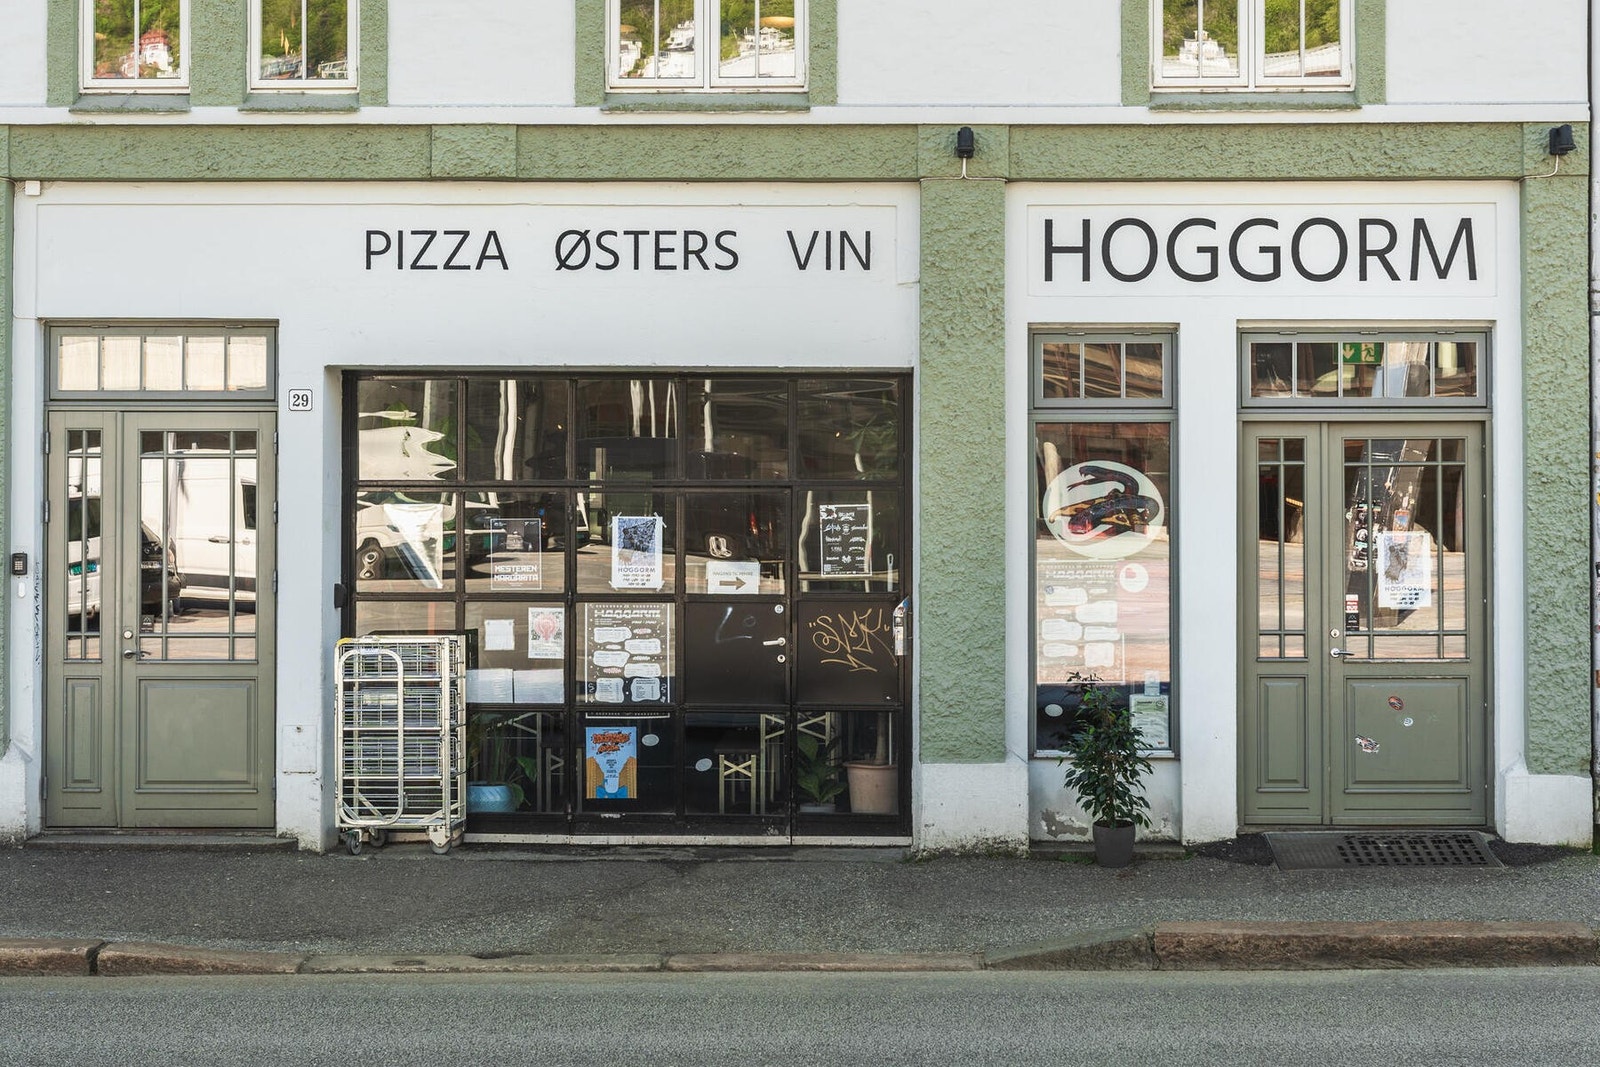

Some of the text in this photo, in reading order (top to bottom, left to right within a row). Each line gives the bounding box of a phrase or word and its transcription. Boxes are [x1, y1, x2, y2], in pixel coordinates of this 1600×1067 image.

[365, 229, 871, 271] PIZZA ØSTERS VIN
[1044, 217, 1478, 283] HOGGORM
[292, 393, 309, 407] 29
[494, 565, 537, 573] MESTEREN
[494, 574, 538, 582] MARGARITA
